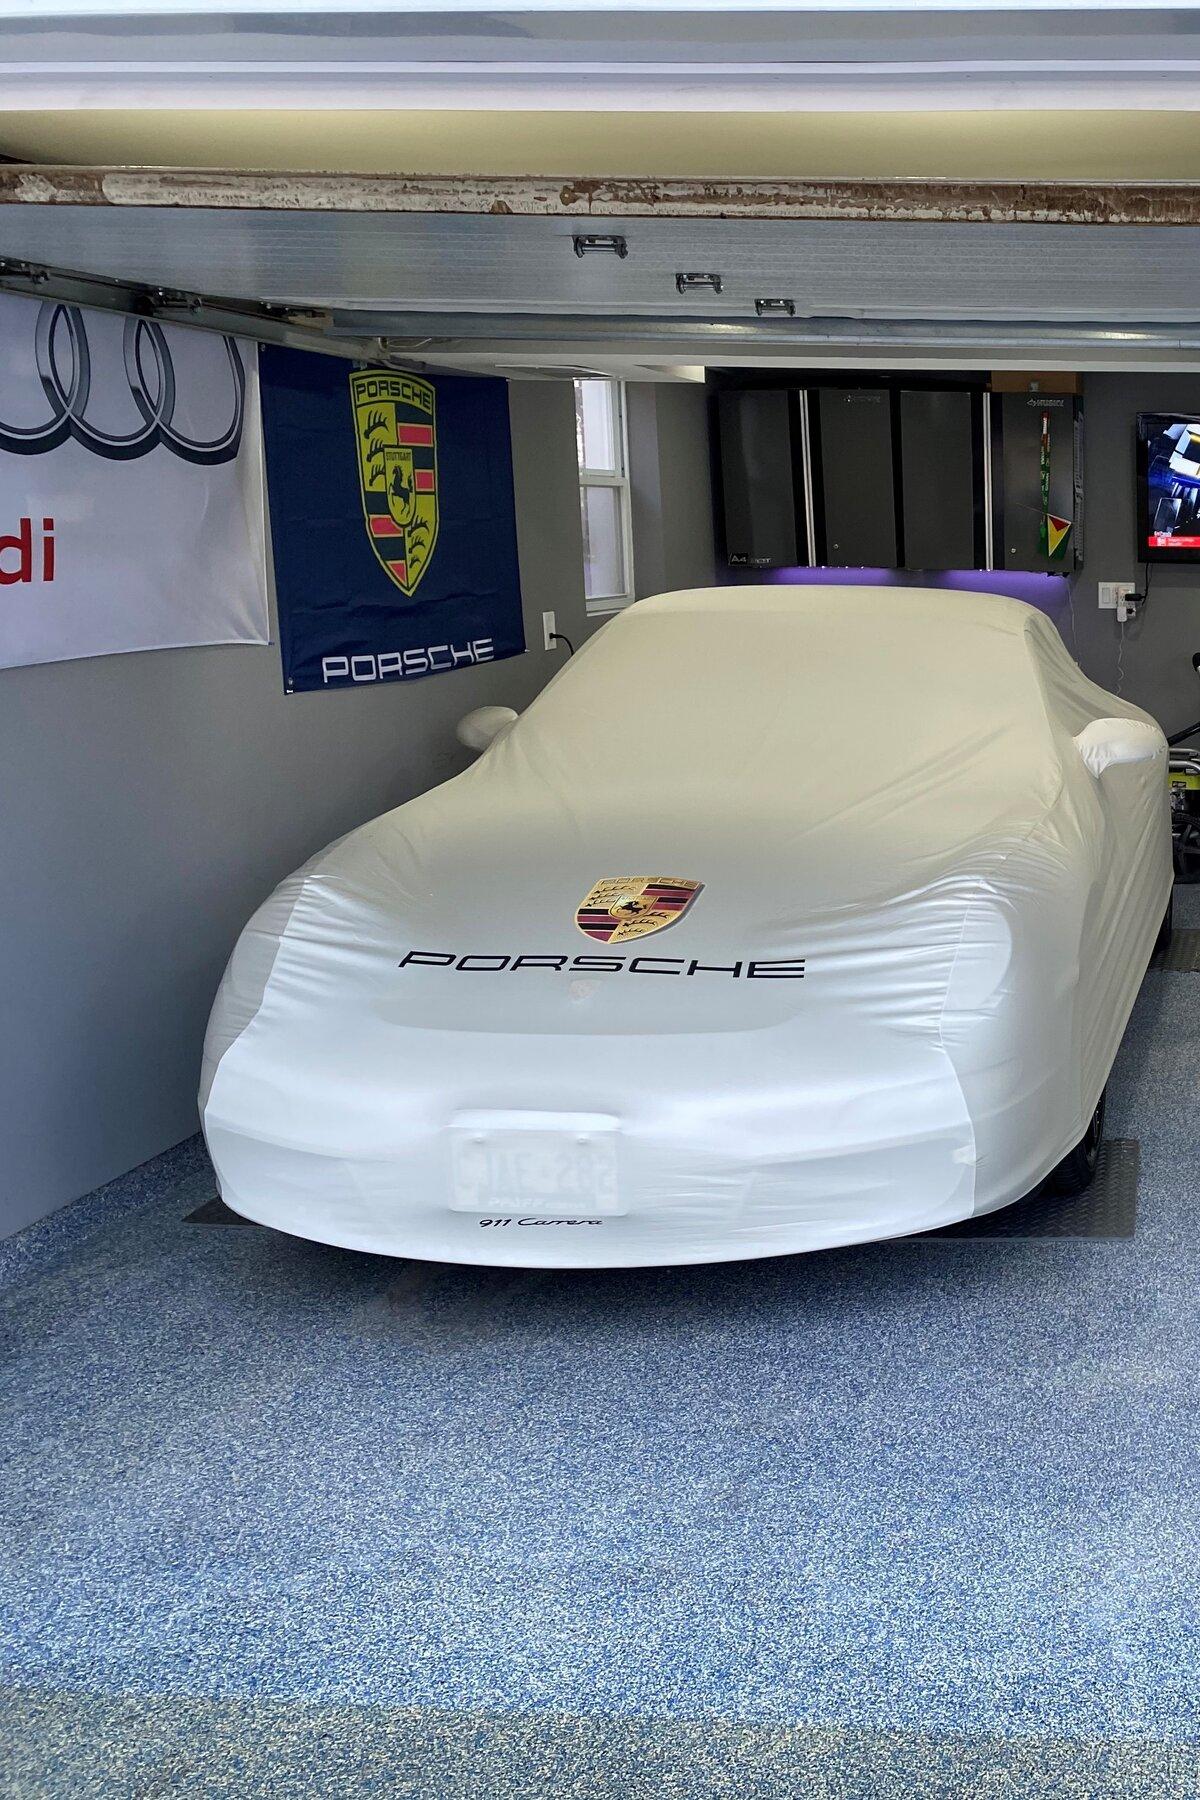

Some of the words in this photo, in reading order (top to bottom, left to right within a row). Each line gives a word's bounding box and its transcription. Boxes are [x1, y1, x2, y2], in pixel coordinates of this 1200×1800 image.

[355, 380, 432, 411] PORSCHE
[322, 638, 494, 683] PORSCHE
[398, 950, 806, 979] PORSCHE
[479, 1218, 512, 1227] 911
[517, 1217, 603, 1226] Carrera
